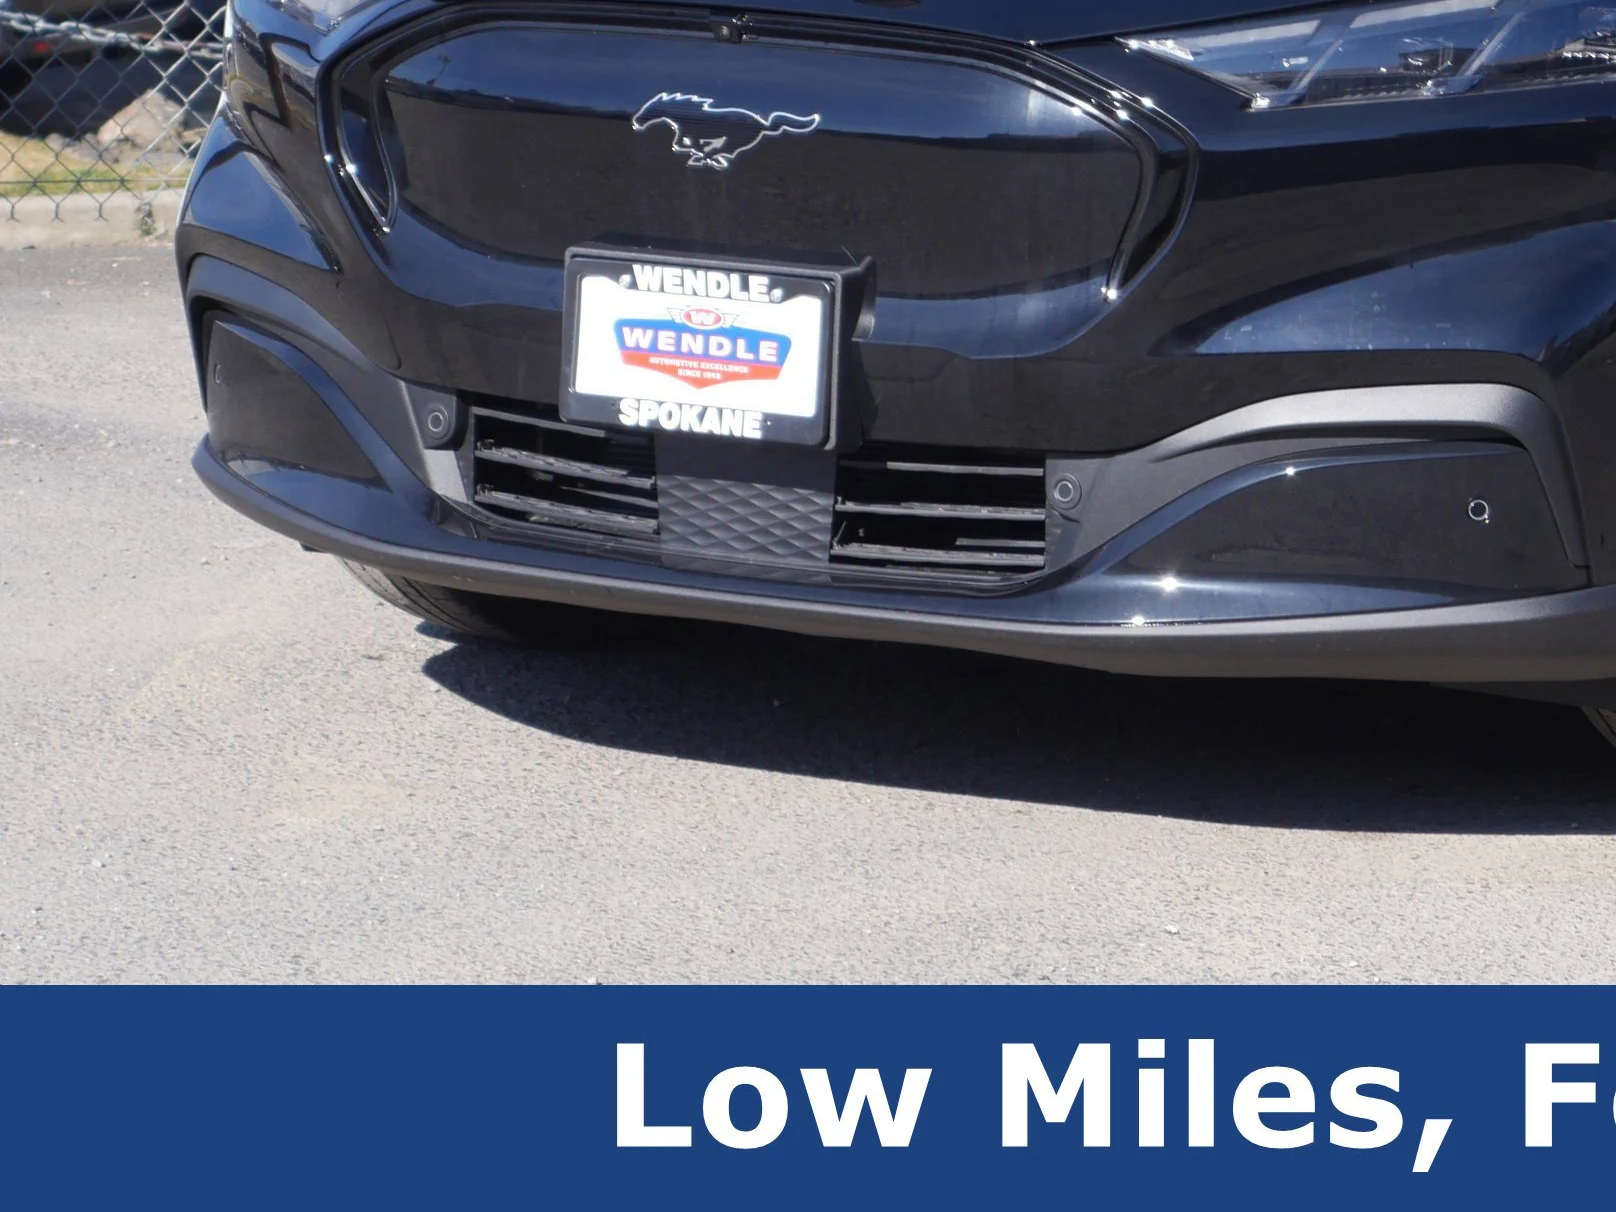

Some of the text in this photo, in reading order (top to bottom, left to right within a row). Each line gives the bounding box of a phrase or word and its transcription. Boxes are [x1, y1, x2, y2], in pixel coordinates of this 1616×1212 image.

[631, 263, 771, 304] WENDLE
[621, 326, 780, 363] WENDLE
[648, 356, 749, 374] AUTOMOTIVE EXCELLENCE
[618, 397, 763, 439] SPOKANE
